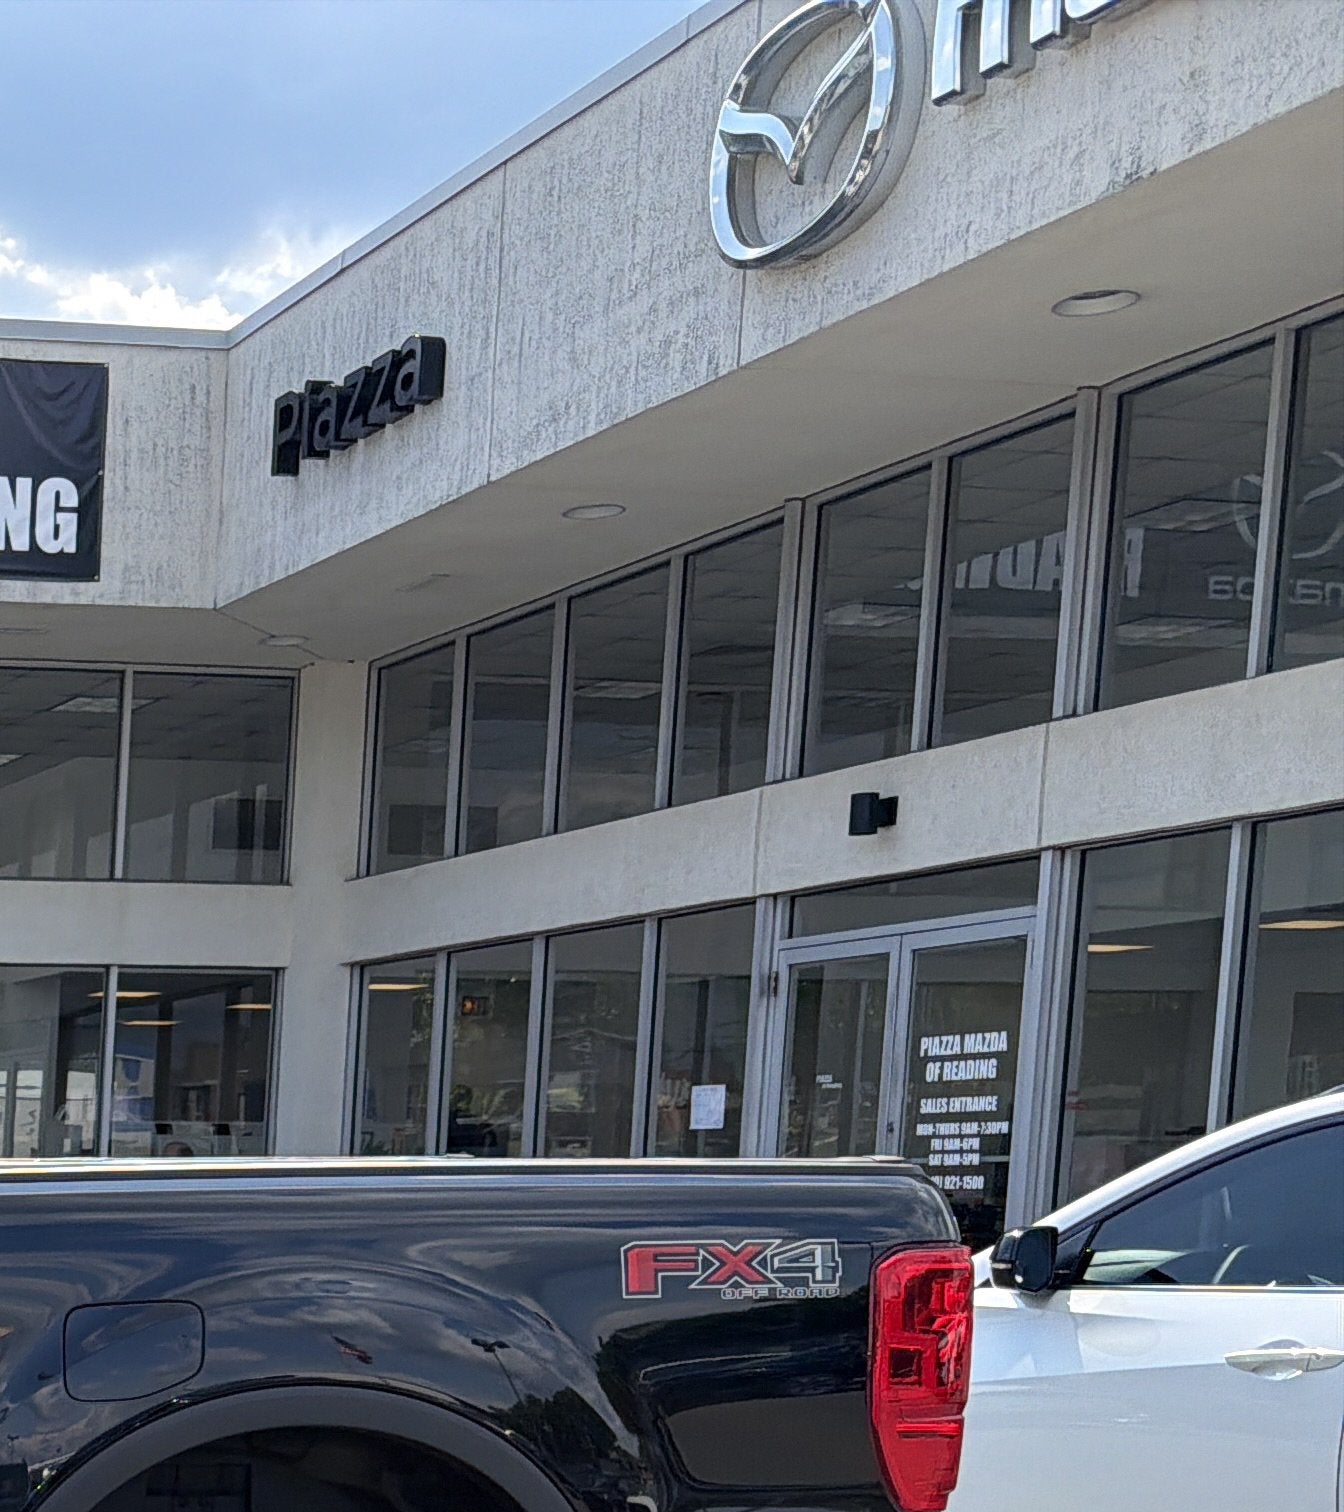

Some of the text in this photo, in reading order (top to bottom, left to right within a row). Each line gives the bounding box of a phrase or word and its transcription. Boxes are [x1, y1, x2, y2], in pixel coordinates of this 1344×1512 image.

[271, 334, 446, 476] Piazza
[919, 1031, 1008, 1057] PIAZZA MAZDA
[925, 1058, 998, 1083] OF READING
[919, 1095, 998, 1114] SALES ENTRANCE
[930, 1137, 980, 1151] FRI 9AM-6PM
[928, 1153, 943, 1166] SAT
[621, 1239, 842, 1298] FX4
[720, 1286, 840, 1300] OFF ROAD
